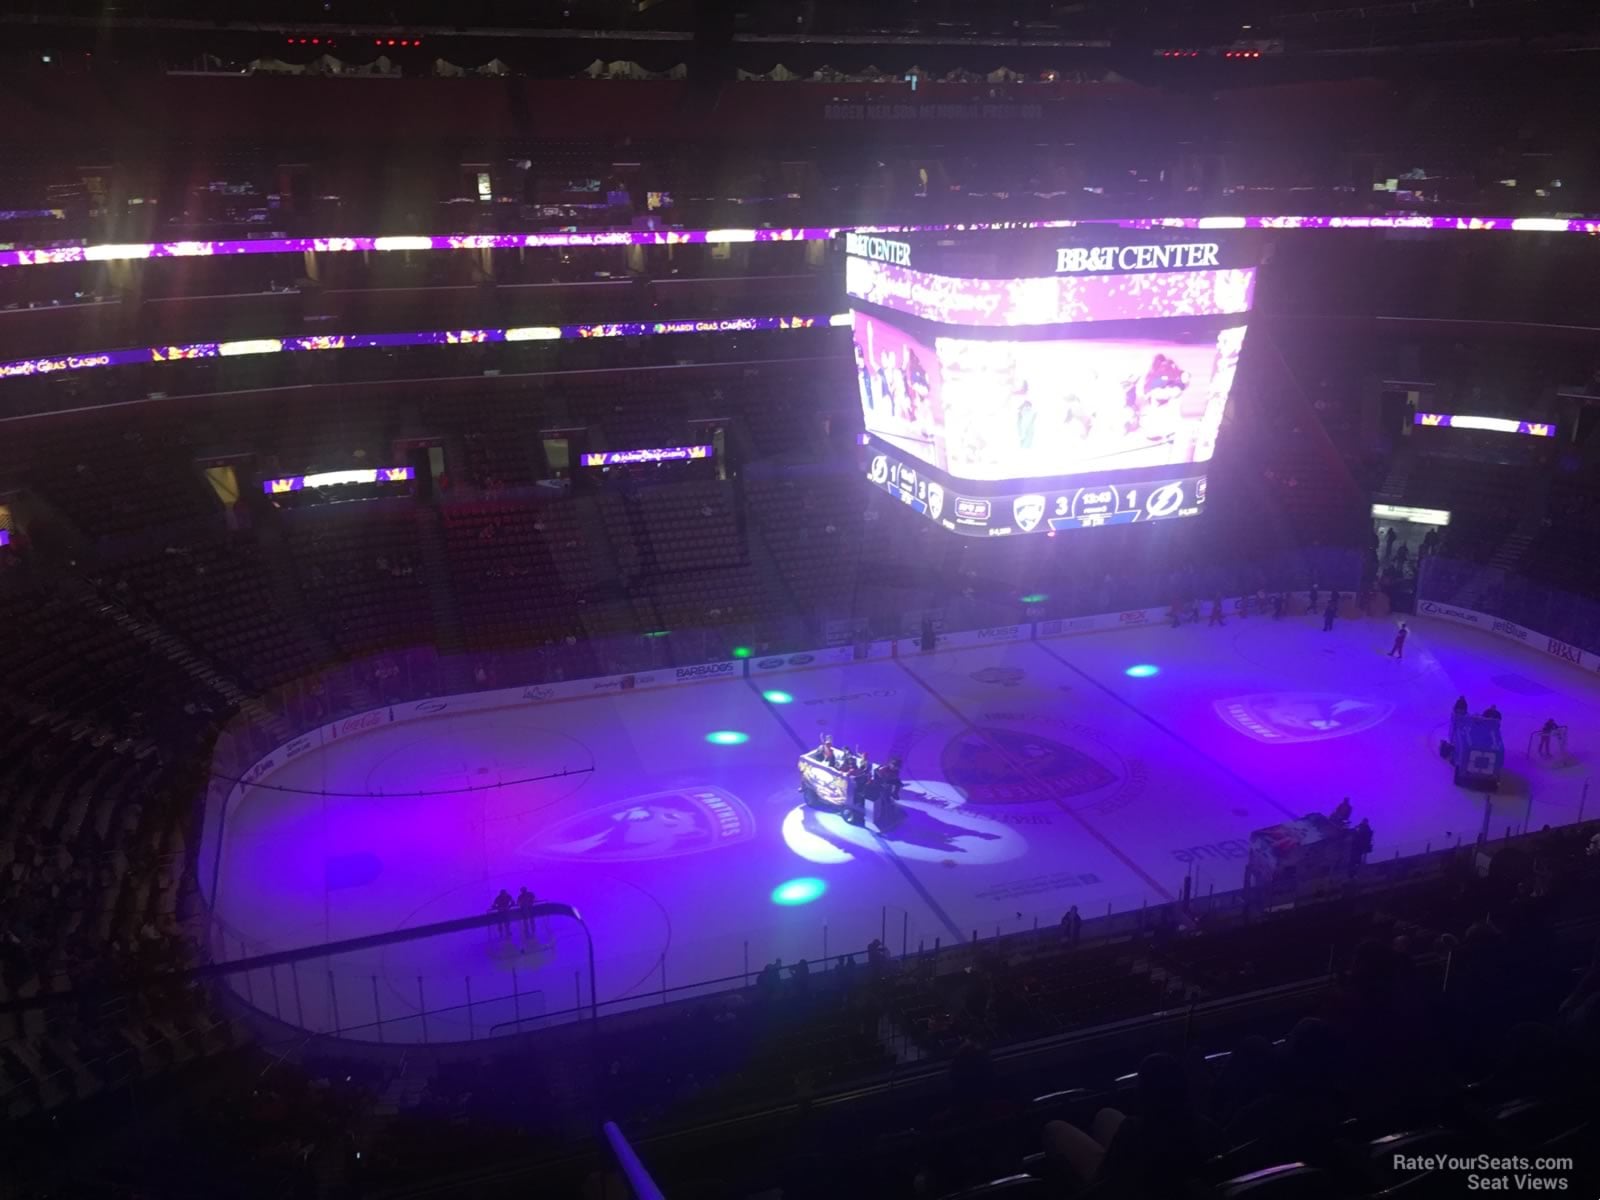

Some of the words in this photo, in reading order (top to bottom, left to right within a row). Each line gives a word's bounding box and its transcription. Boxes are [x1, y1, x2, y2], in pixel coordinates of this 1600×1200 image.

[868, 237, 912, 267] CENTER
[1055, 246, 1119, 272] BB&T
[1118, 243, 1219, 270] CENTER
[1055, 496, 1069, 516] 3
[1126, 490, 1138, 508] 1
[675, 662, 734, 678] BARBADOS
[693, 792, 741, 838] PANTHERS
